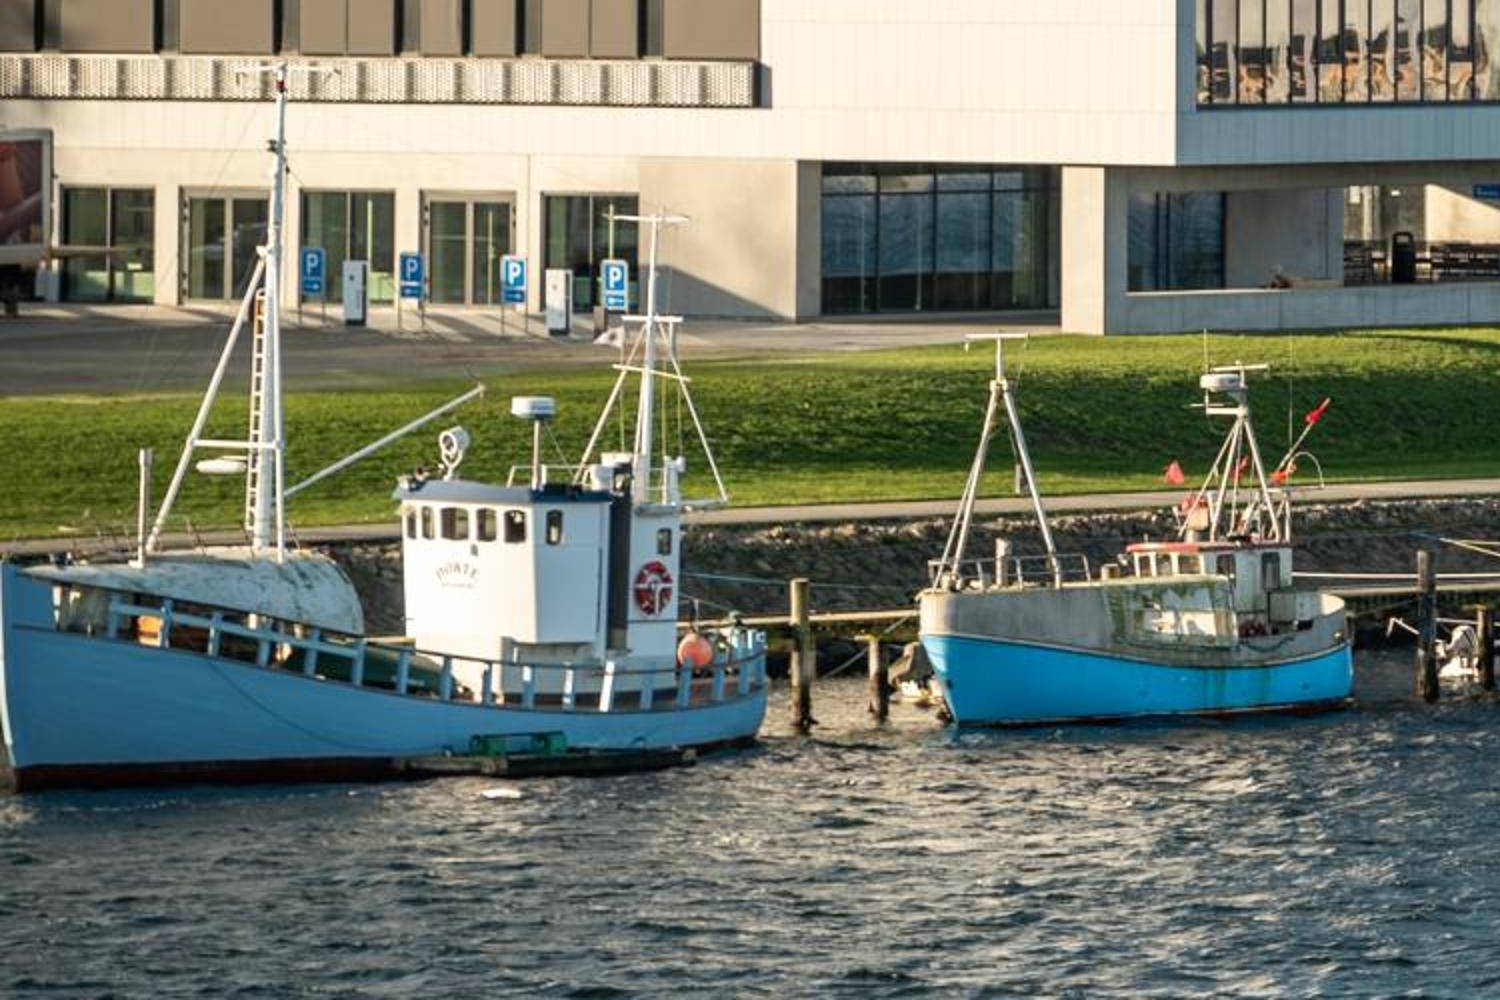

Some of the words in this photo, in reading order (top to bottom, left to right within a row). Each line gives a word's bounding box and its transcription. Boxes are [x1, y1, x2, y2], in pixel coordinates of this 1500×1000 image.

[306, 253, 319, 276] P
[405, 258, 419, 280] P
[508, 262, 521, 285] P
[609, 266, 622, 289] P
